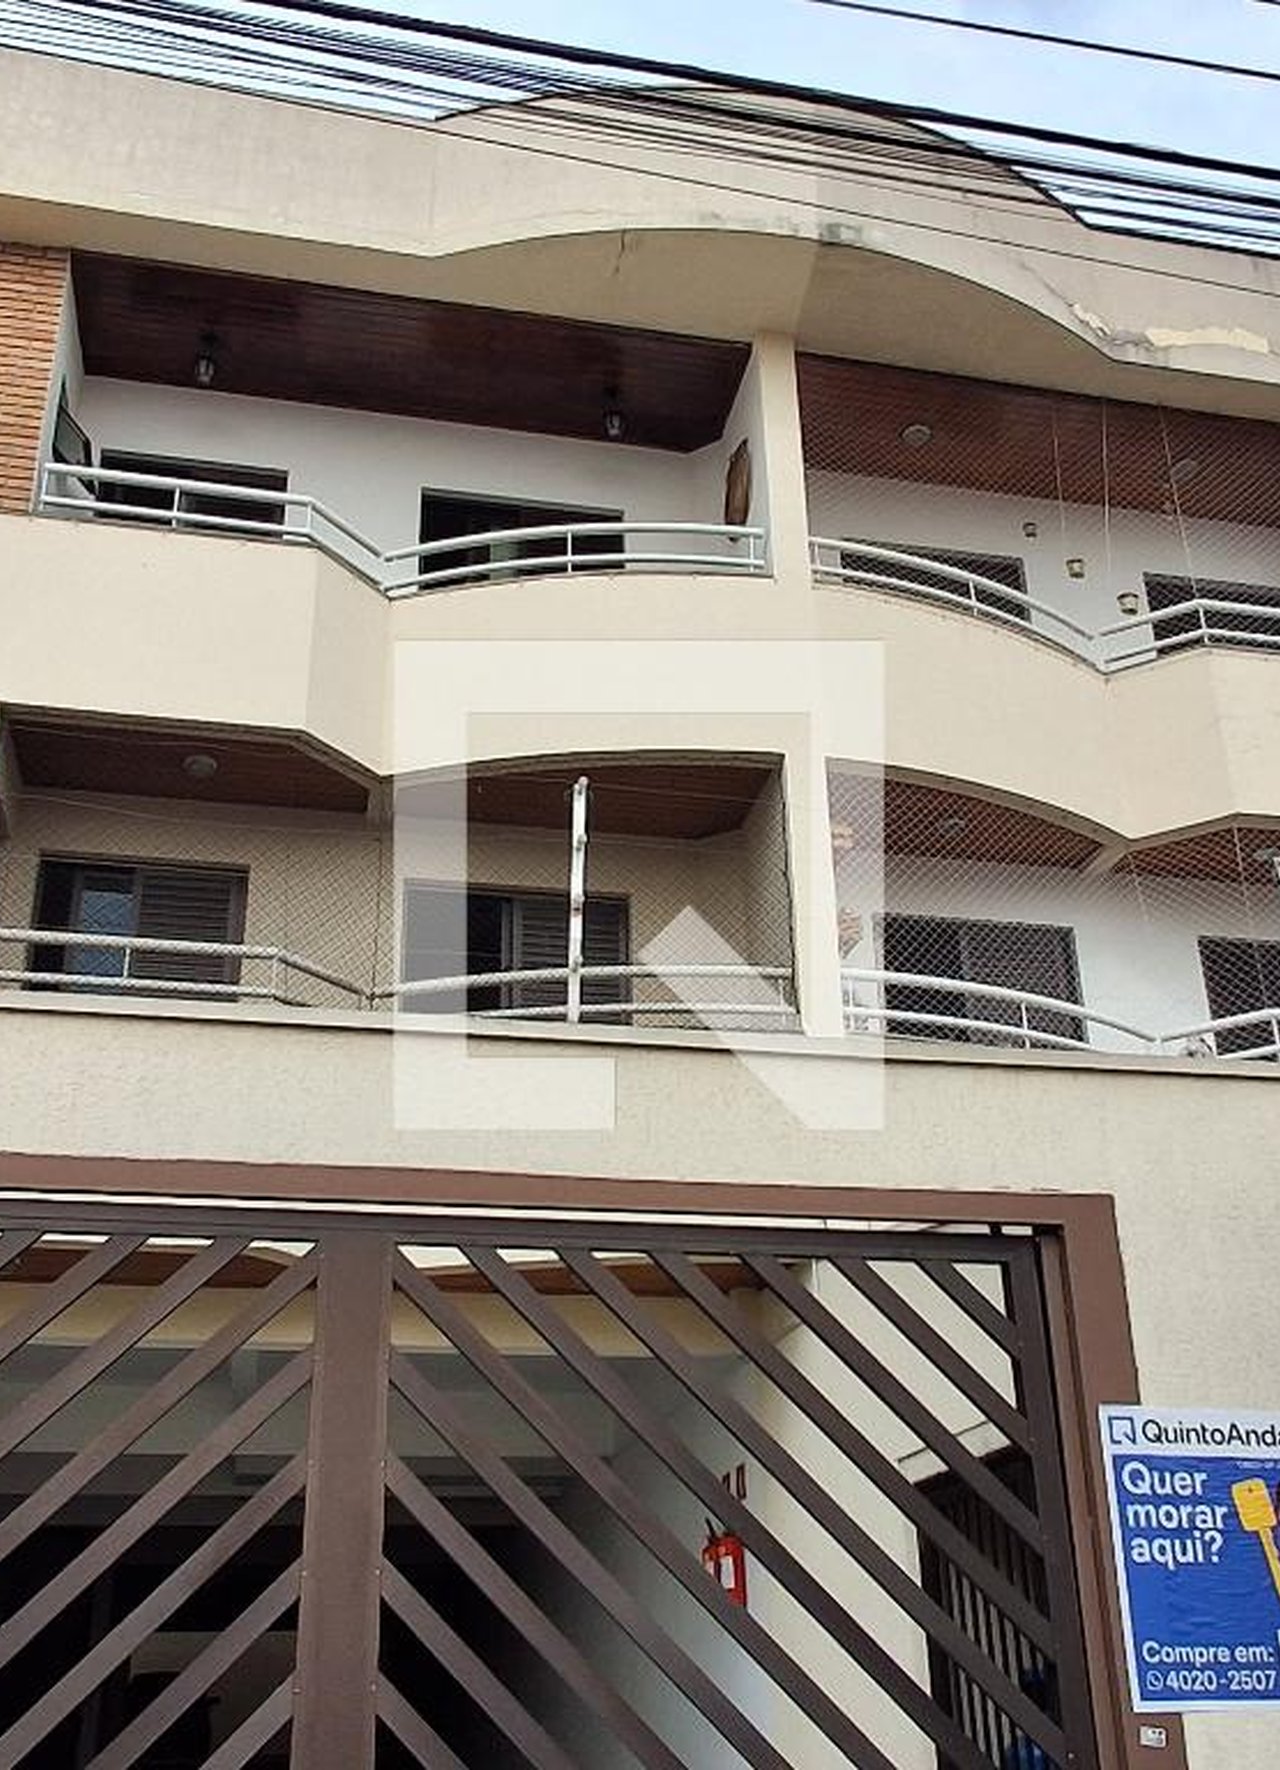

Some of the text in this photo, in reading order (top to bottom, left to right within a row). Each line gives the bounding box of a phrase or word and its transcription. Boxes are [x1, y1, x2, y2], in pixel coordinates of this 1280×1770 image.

[1121, 1461, 1208, 1496] Quer
[1126, 1503, 1228, 1530] morar
[1130, 1531, 1224, 1569] aqui?
[1142, 1641, 1275, 1668] Compre em:
[1167, 1671, 1276, 1690] 4020-2507
